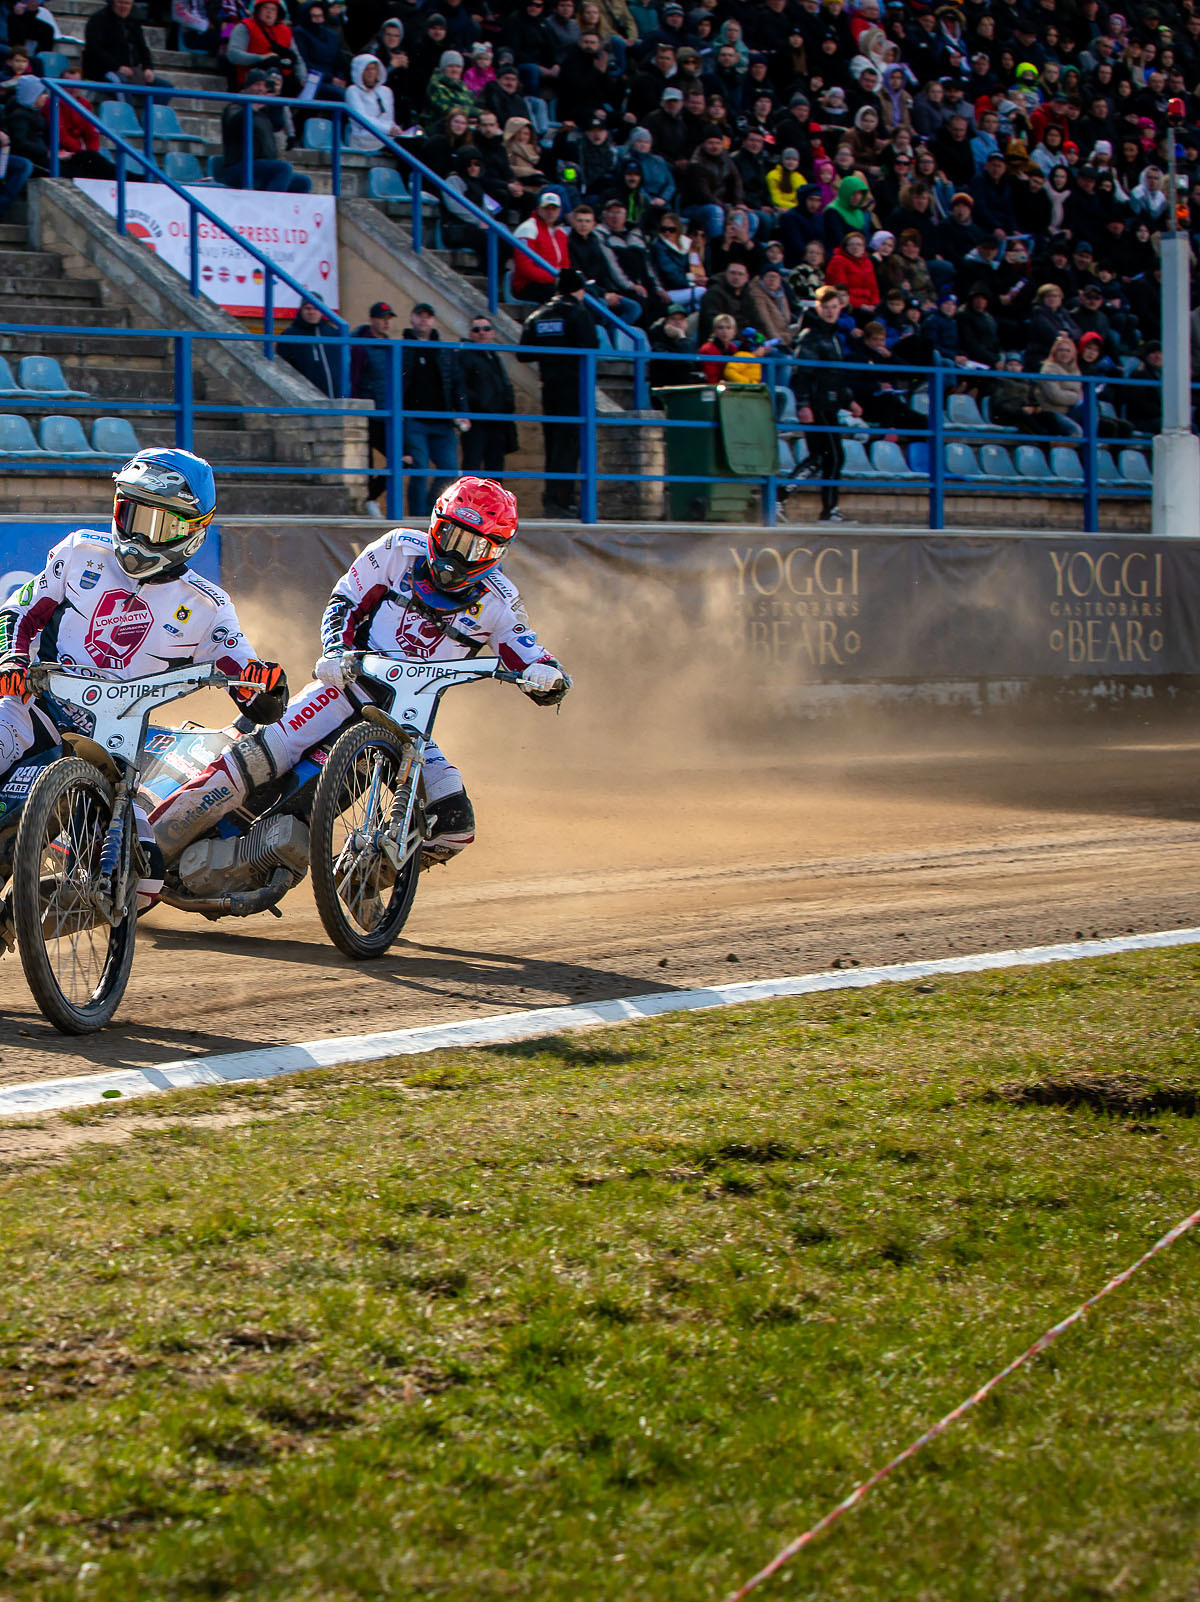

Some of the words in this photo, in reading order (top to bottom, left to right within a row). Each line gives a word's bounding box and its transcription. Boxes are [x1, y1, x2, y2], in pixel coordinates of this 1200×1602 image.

[729, 547, 859, 596] YOGGI
[1049, 551, 1163, 597] YOGGI
[96, 612, 148, 627] LOKOMOTIV
[750, 620, 845, 665] BEAR
[1069, 620, 1151, 662] BEAR
[106, 684, 169, 700] OPTIBET
[406, 666, 460, 681] OPTIBET
